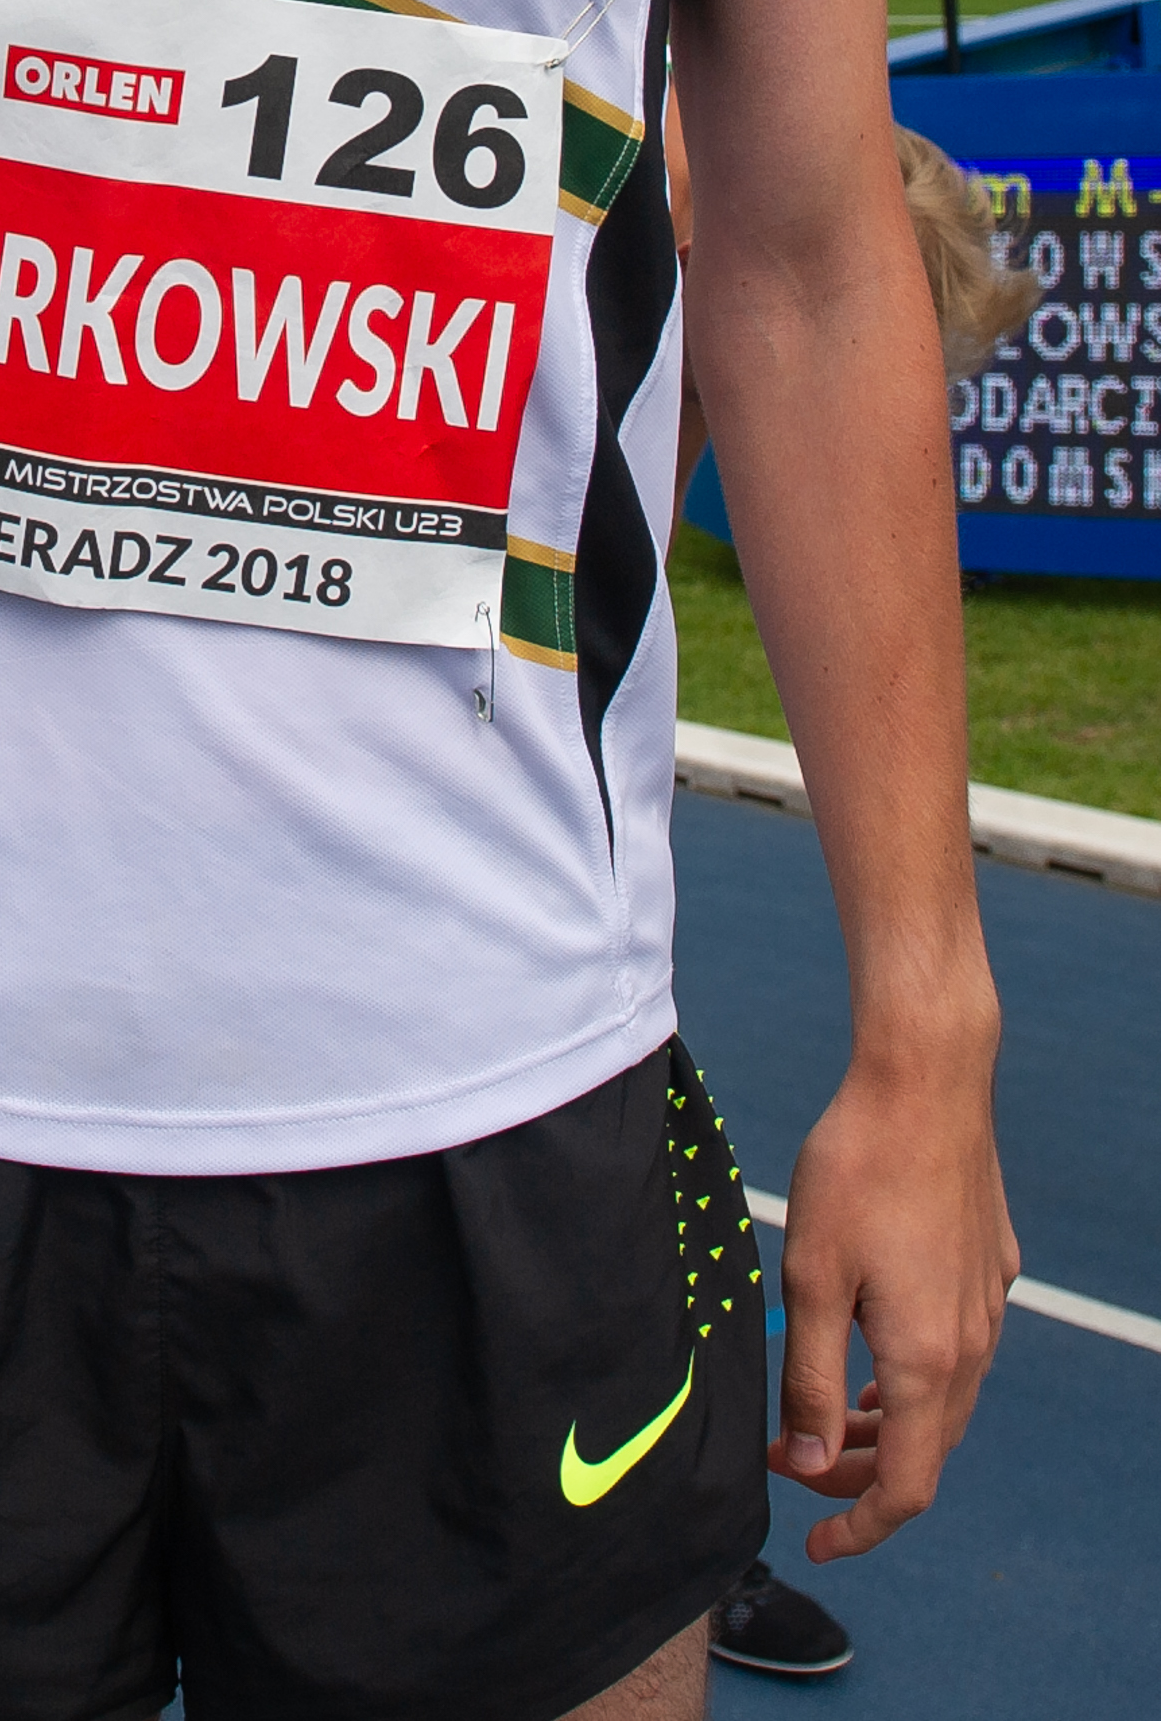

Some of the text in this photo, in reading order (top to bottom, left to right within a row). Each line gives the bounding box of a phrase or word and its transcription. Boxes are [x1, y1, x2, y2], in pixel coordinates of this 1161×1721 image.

[13, 55, 175, 117] ORLEN
[221, 54, 529, 209] 126
[4, 458, 254, 515] MISTRZOSTWA
[263, 494, 386, 532] POLSKI
[395, 510, 463, 537] U23
[201, 542, 353, 608] 2018
